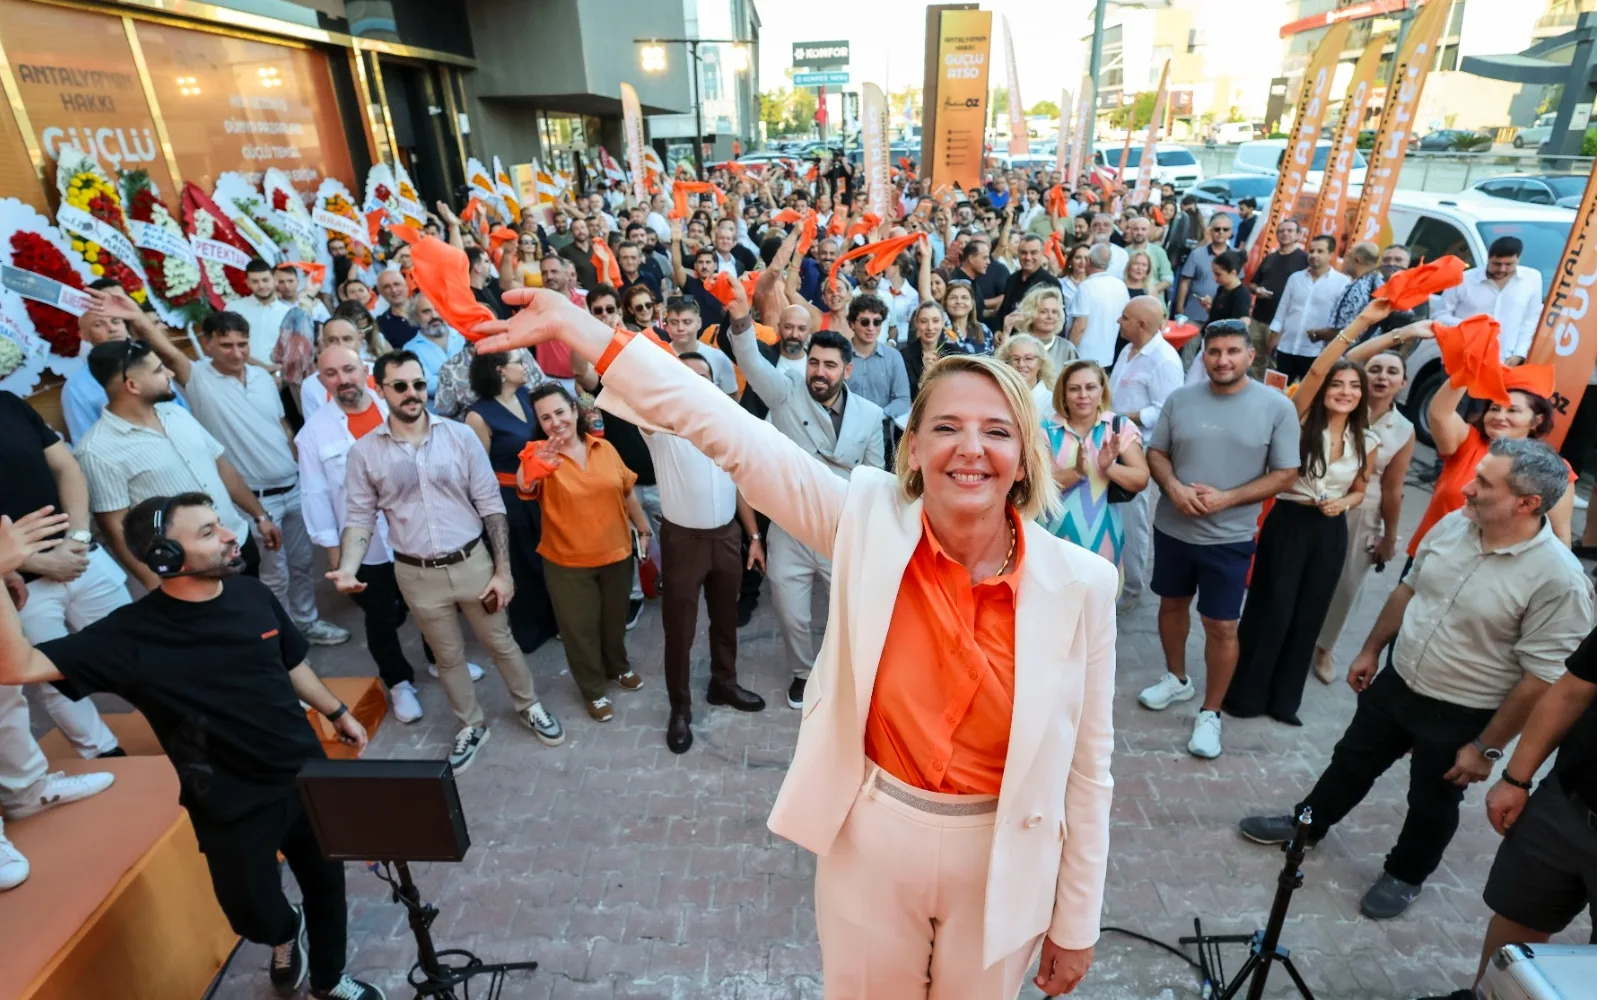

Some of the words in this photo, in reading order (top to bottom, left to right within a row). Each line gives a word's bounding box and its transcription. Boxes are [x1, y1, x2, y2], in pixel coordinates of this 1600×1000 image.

[805, 47, 848, 59] KONFOR
[947, 67, 980, 79] ATSO
[60, 93, 117, 113] HAKKI
[1294, 66, 1328, 166] ATSO
[1336, 80, 1367, 174] ATSO
[43, 126, 156, 171] GÜÇLÜ
